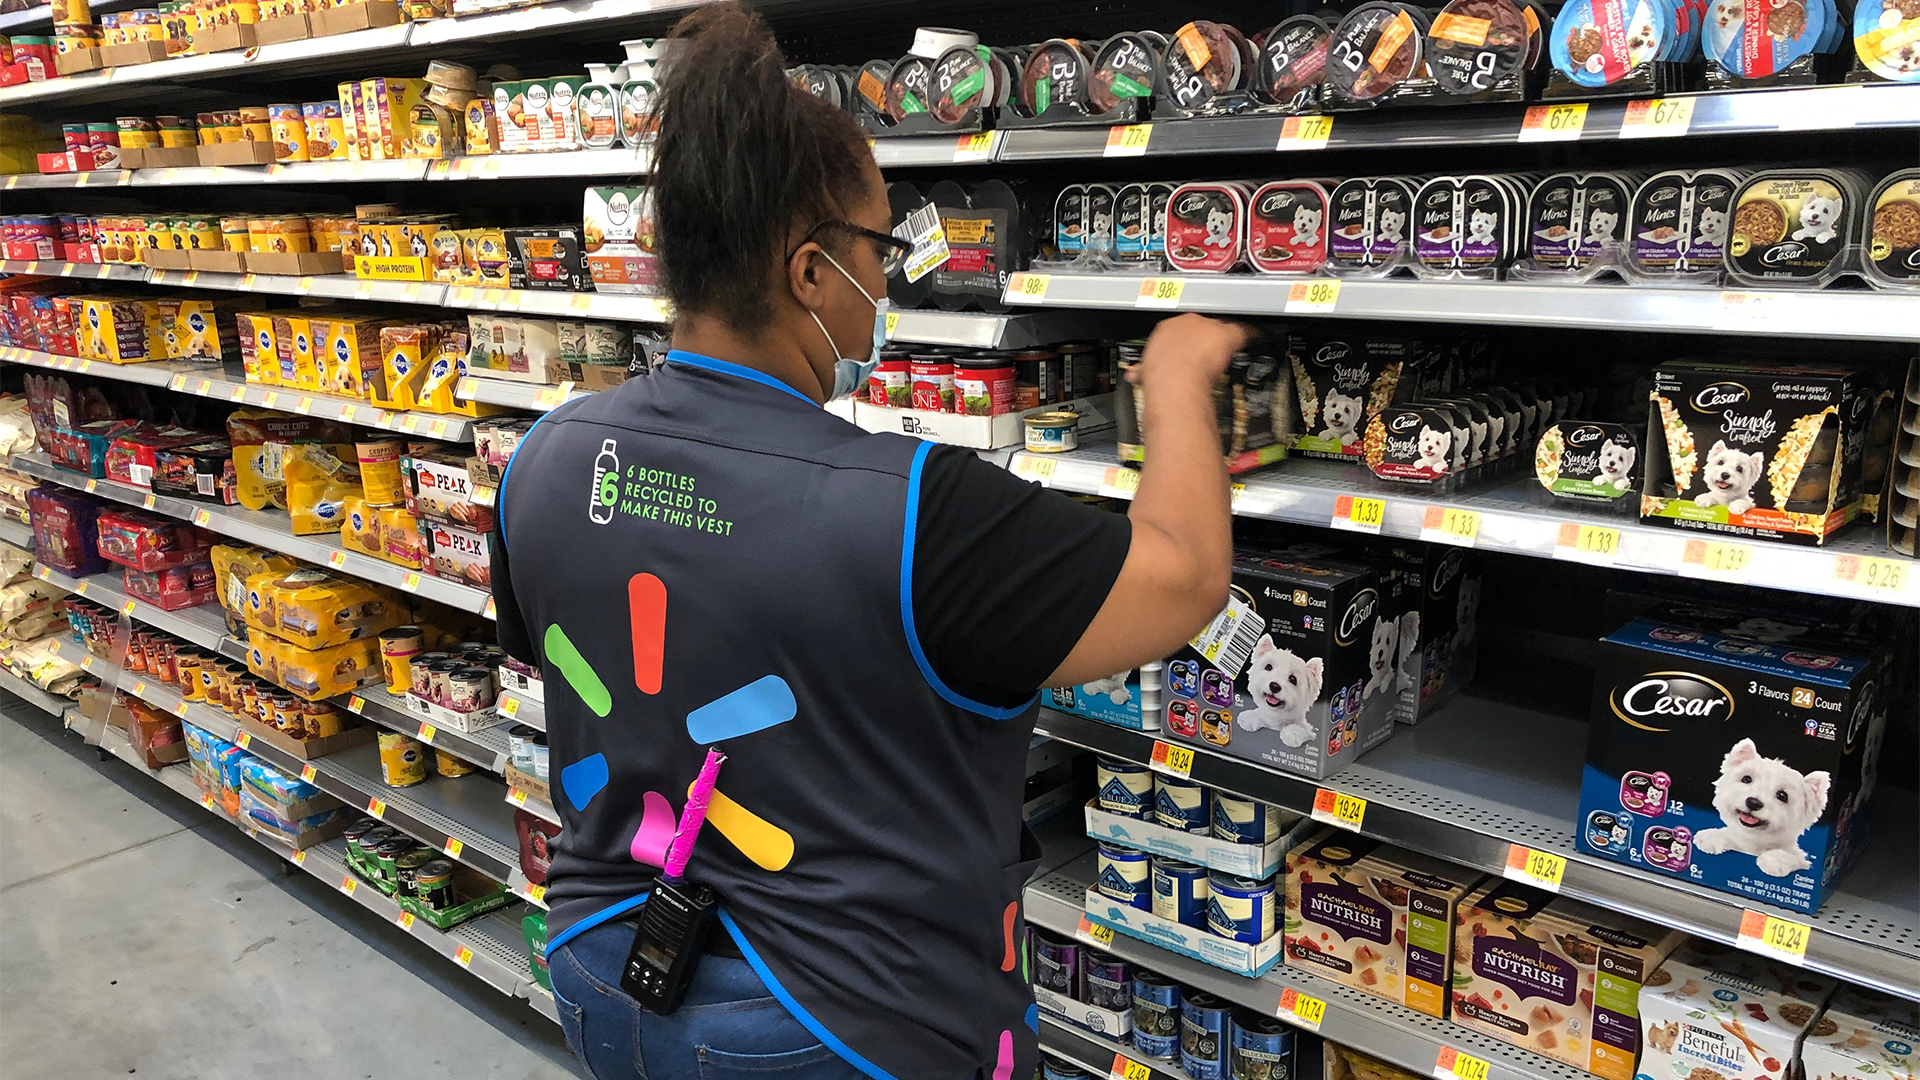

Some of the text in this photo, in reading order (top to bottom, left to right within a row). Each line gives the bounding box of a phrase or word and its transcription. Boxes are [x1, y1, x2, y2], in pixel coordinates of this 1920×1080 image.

[1605, 3, 1615, 30] DINNER
[1347, 22, 1362, 40] PURE
[1744, 28, 1752, 74] HOMESTYLE
[1427, 191, 1493, 206] Cesar Cesar
[1650, 188, 1728, 203] Cesar Cesar
[609, 202, 628, 213] Nutro
[1179, 198, 1206, 214] Cesar
[1261, 196, 1291, 213] Cesar
[1121, 211, 1140, 223] Minis
[1338, 208, 1363, 222] Minis
[1424, 210, 1450, 225] Minis
[1540, 209, 1569, 222] Minis
[1644, 209, 1676, 224] Minis
[1763, 245, 1806, 263] Cesar
[375, 264, 415, 274] HIGH PROTEIN
[1316, 346, 1348, 362] Cesar
[1333, 362, 1370, 384] Simply
[1655, 372, 1661, 380] 8
[1772, 382, 1828, 394] Great topper,
[870, 391, 884, 404] NE
[912, 392, 937, 408] ONE
[1696, 387, 1745, 407] Cesar
[1808, 392, 1831, 401] snack!
[292, 422, 310, 430] CUTS
[1392, 417, 1419, 430] Cesar
[1721, 409, 1777, 437] Simply
[1571, 429, 1601, 443] Cesar
[1730, 430, 1763, 445] Crafted
[1387, 436, 1417, 454] Simply
[1563, 450, 1599, 470] Simply
[437, 474, 466, 494] PEAK
[627, 464, 695, 492] 6 BOTTLES
[600, 471, 620, 507] 6
[625, 482, 717, 514] RECYCLED TO
[620, 500, 734, 536] MAKE THIS VEST
[452, 534, 482, 556] PEAK
[1867, 563, 1900, 588] 9.26
[1264, 587, 1327, 608] 4 Flavors 24 Count
[1339, 600, 1377, 639] Cesar
[1623, 679, 1725, 716] Cesar
[1748, 681, 1842, 711] 3 Flavors 24 Count
[1107, 794, 1127, 803] BLUE
[1671, 800, 1684, 811] 12
[1630, 848, 1637, 856] 6
[1690, 864, 1697, 873] 6
[1104, 881, 1121, 891] BLUE
[1793, 879, 1814, 890] Cuisine
[1795, 874, 1815, 884] Canine
[1727, 880, 1743, 891] TOTAL
[1744, 885, 1756, 894] NET
[1767, 891, 1776, 899] 2.4
[1784, 896, 1799, 906] (5.29
[1800, 900, 1810, 909] LB)
[1769, 884, 1780, 892] (3.5
[1781, 887, 1791, 895] OZ)
[1792, 890, 1811, 900] TRAYS
[661, 893, 689, 913] MOTOROLA
[1317, 893, 1375, 914] RACHAEL RAY
[1423, 905, 1443, 915] COUNT
[1310, 898, 1382, 929] NUTRISH
[1323, 915, 1340, 924] PREMIUM
[1350, 923, 1361, 931] FOOD
[1370, 930, 1382, 938] DOGS
[1308, 951, 1346, 967] Hearty Recipes
[1324, 960, 1336, 968] PACK
[1491, 947, 1558, 973] RACHAEL RAY
[1484, 952, 1565, 989] NUTRISH
[1614, 964, 1638, 976] COUNT
[1483, 967, 1497, 975] SUPER
[1497, 971, 1516, 981] PREMIUM
[1528, 982, 1540, 990] FOOD
[1551, 989, 1564, 997] DOGS
[1703, 975, 1765, 997] IncrediBites
[1478, 1008, 1521, 1028] Hearty Recipes
[1496, 1020, 1509, 1028] PACK
[1690, 1025, 1725, 1041] PURINA
[1682, 1030, 1740, 1061] Beneful
[1240, 1049, 1281, 1062] WILDERNESS
[1677, 1043, 1743, 1072] IncrediBites
